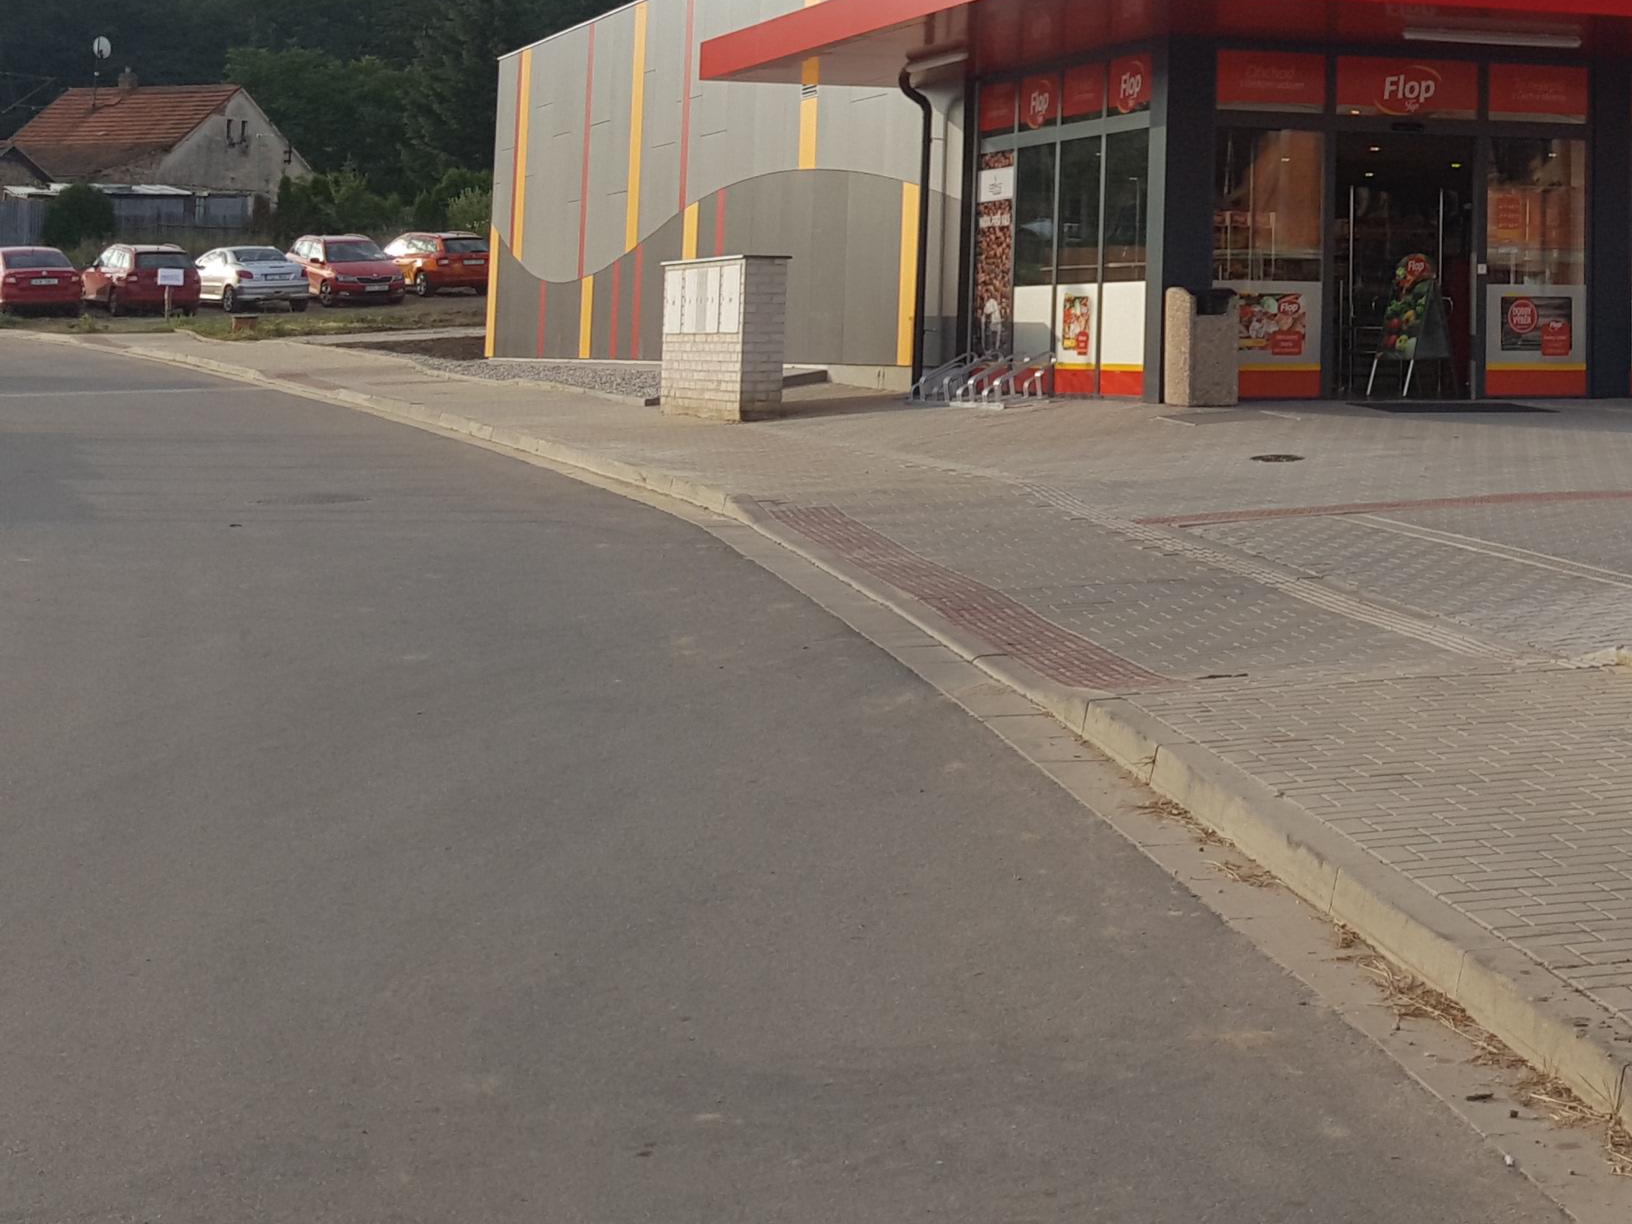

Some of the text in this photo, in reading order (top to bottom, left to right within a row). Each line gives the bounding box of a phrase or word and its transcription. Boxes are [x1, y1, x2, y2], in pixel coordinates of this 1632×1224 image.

[1120, 71, 1142, 99] Flop
[1383, 74, 1436, 103] Flop
[1030, 89, 1050, 116] Flop
[1407, 260, 1425, 273] Flop
[1280, 302, 1299, 315] Flop
